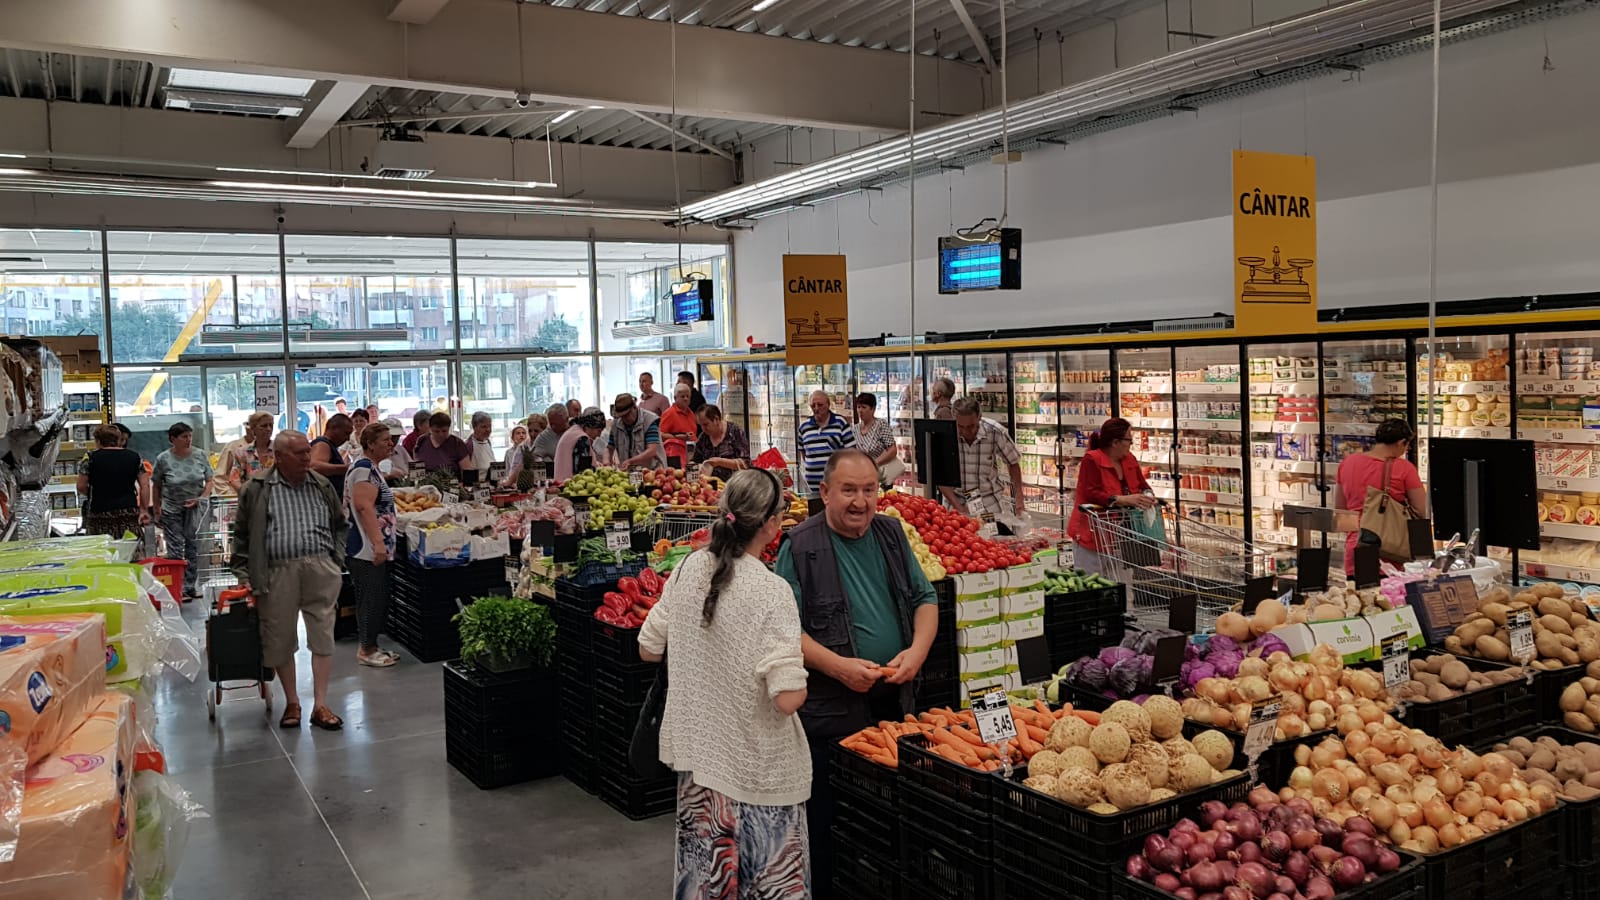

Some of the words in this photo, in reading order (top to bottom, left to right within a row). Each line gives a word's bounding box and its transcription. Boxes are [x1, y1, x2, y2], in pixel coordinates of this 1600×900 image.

[1239, 187, 1311, 219] CÂNTAR
[788, 275, 843, 294] CÂNTAR
[257, 397, 267, 407] 29
[616, 535, 629, 546] 9,90
[993, 714, 1013, 737] 5,45
